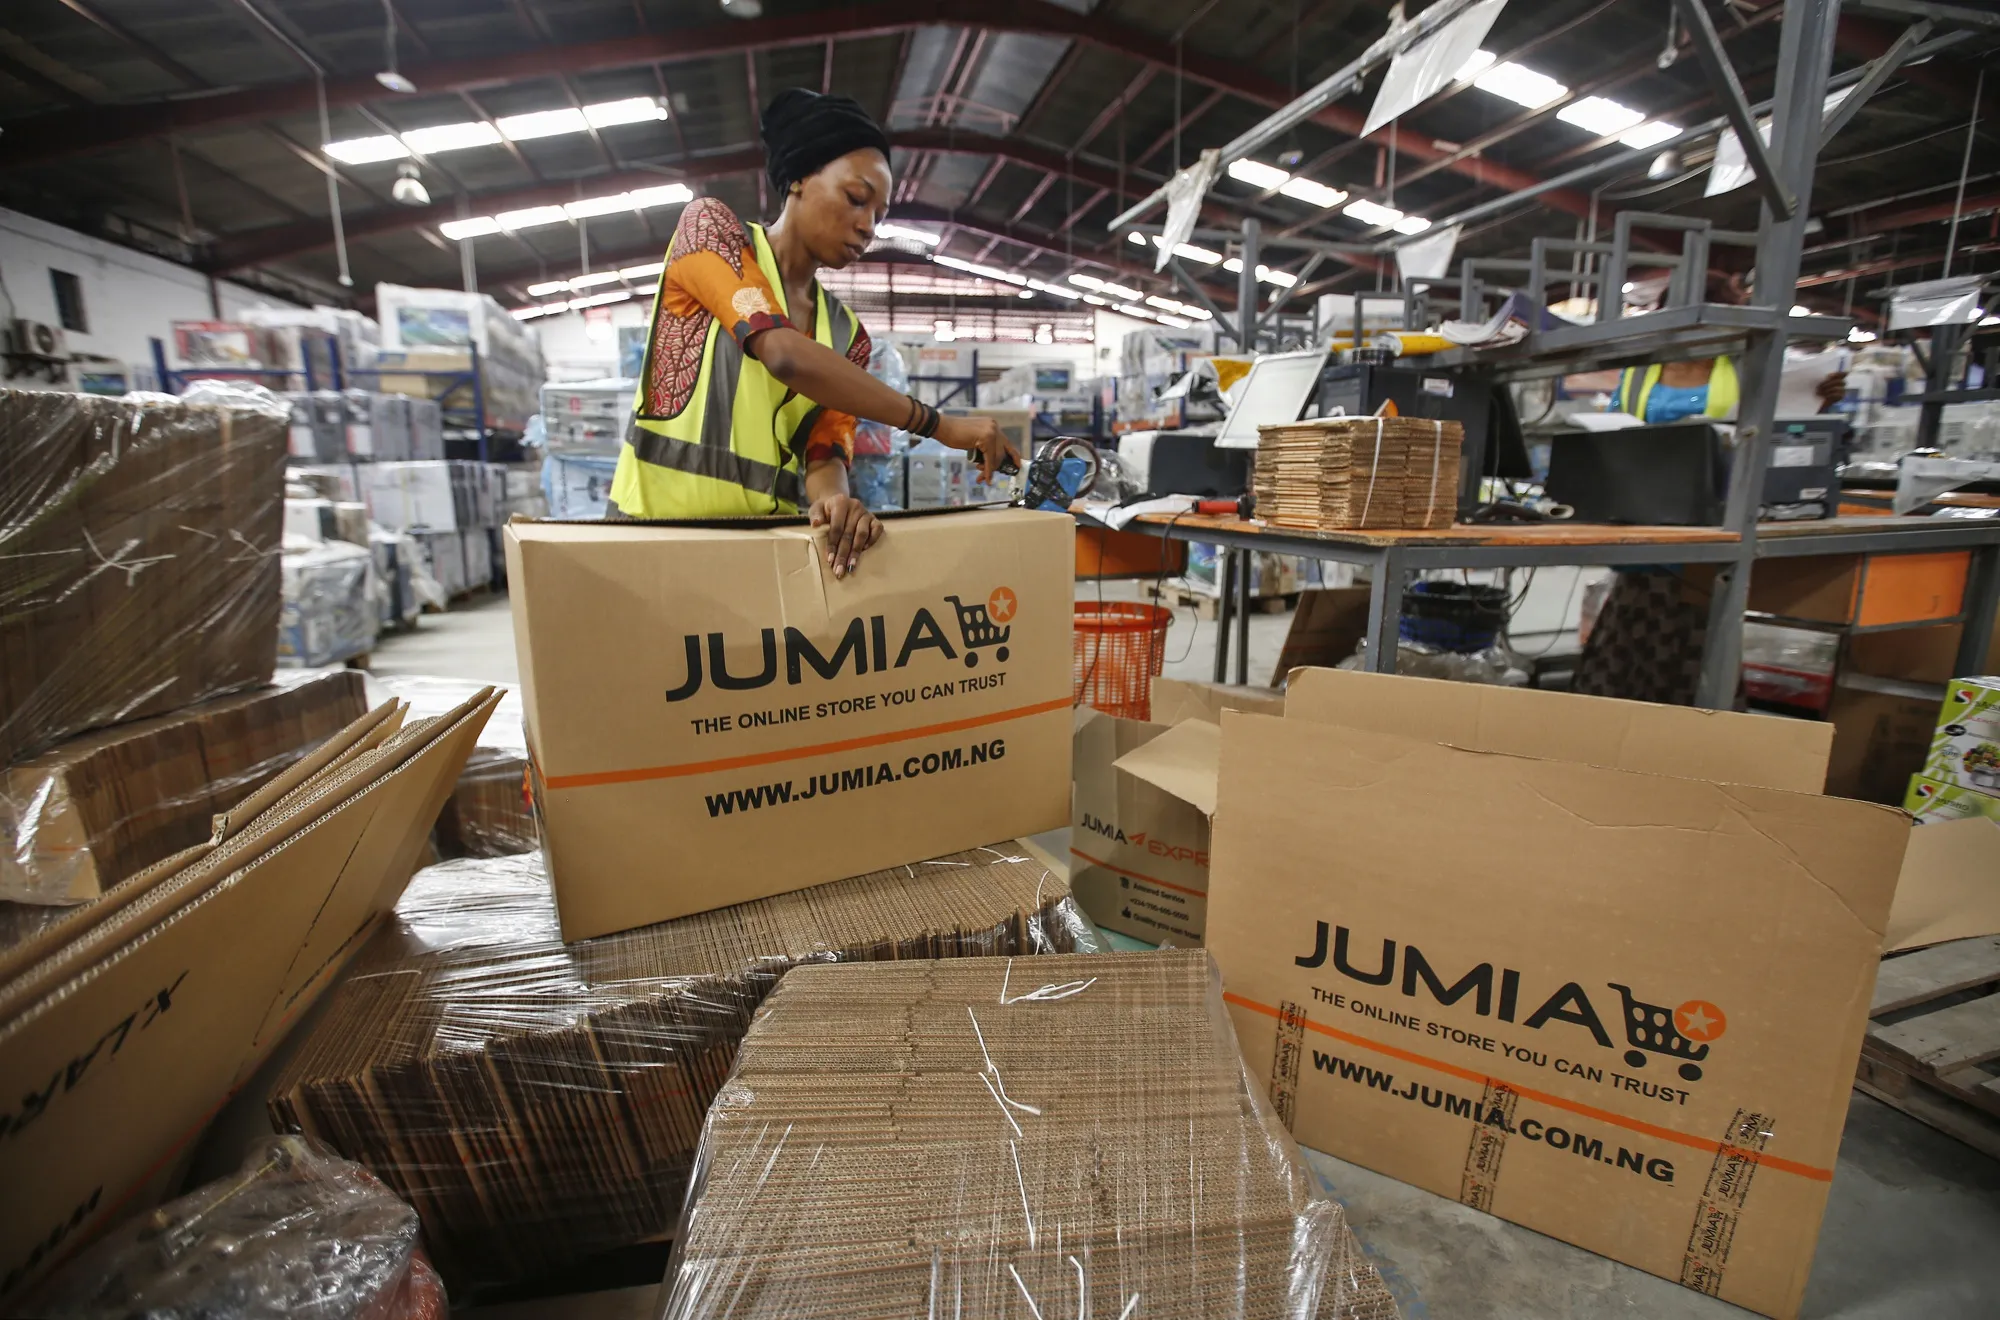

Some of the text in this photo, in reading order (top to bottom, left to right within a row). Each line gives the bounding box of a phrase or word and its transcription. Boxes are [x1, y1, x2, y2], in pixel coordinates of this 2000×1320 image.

[665, 607, 958, 702] JUMIA
[691, 672, 1007, 735] THE ONLINE STORE YOU CAN TRUST
[704, 739, 1006, 818] WWW.JUMIA.COM.NG
[1081, 813, 1128, 845] JUMIA
[1295, 920, 1615, 1050] JUMIA
[1311, 986, 1690, 1107] THE ONLINE STORE YOU CAN TRUST
[1312, 1050, 1675, 1184] WWW.JUMIA.COM.NG
[1718, 1160, 1740, 1197] JUMIA
[1701, 1218, 1720, 1253] JUMIA
